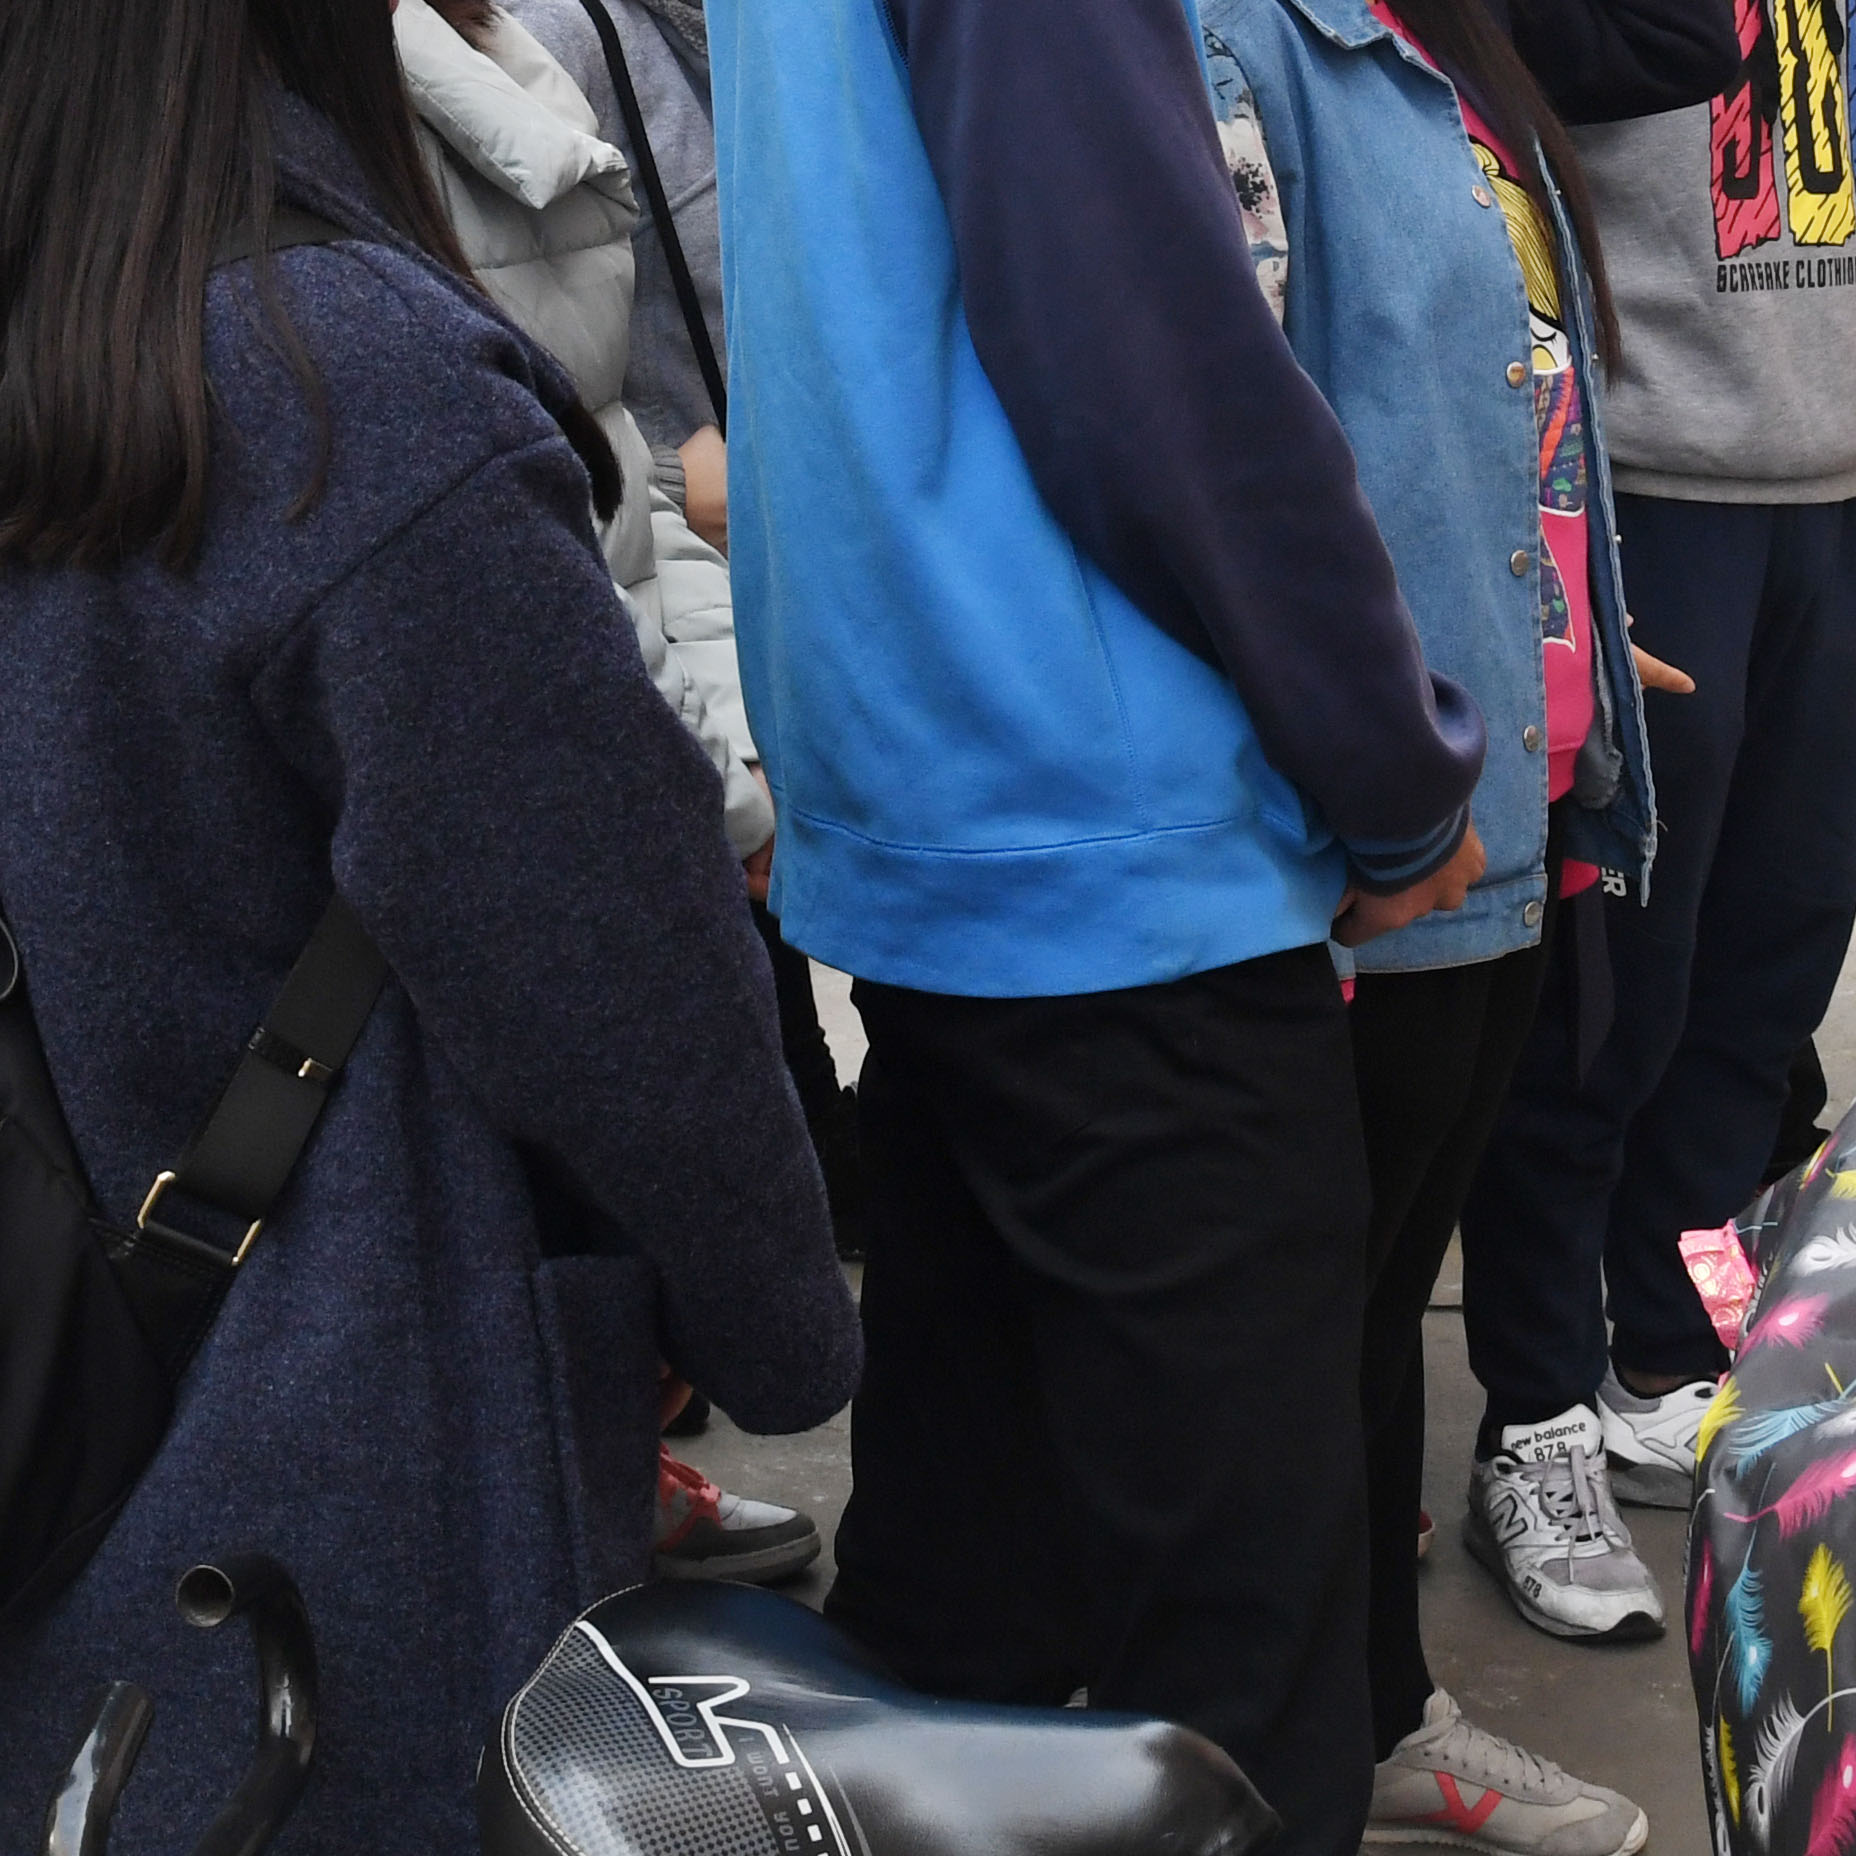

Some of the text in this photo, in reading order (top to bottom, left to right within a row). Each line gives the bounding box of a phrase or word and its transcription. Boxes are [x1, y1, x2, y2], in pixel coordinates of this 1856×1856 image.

[1510, 1420, 1587, 1452] new balance
[1533, 1440, 1568, 1463] 878
[652, 1687, 713, 1759] SPORT
